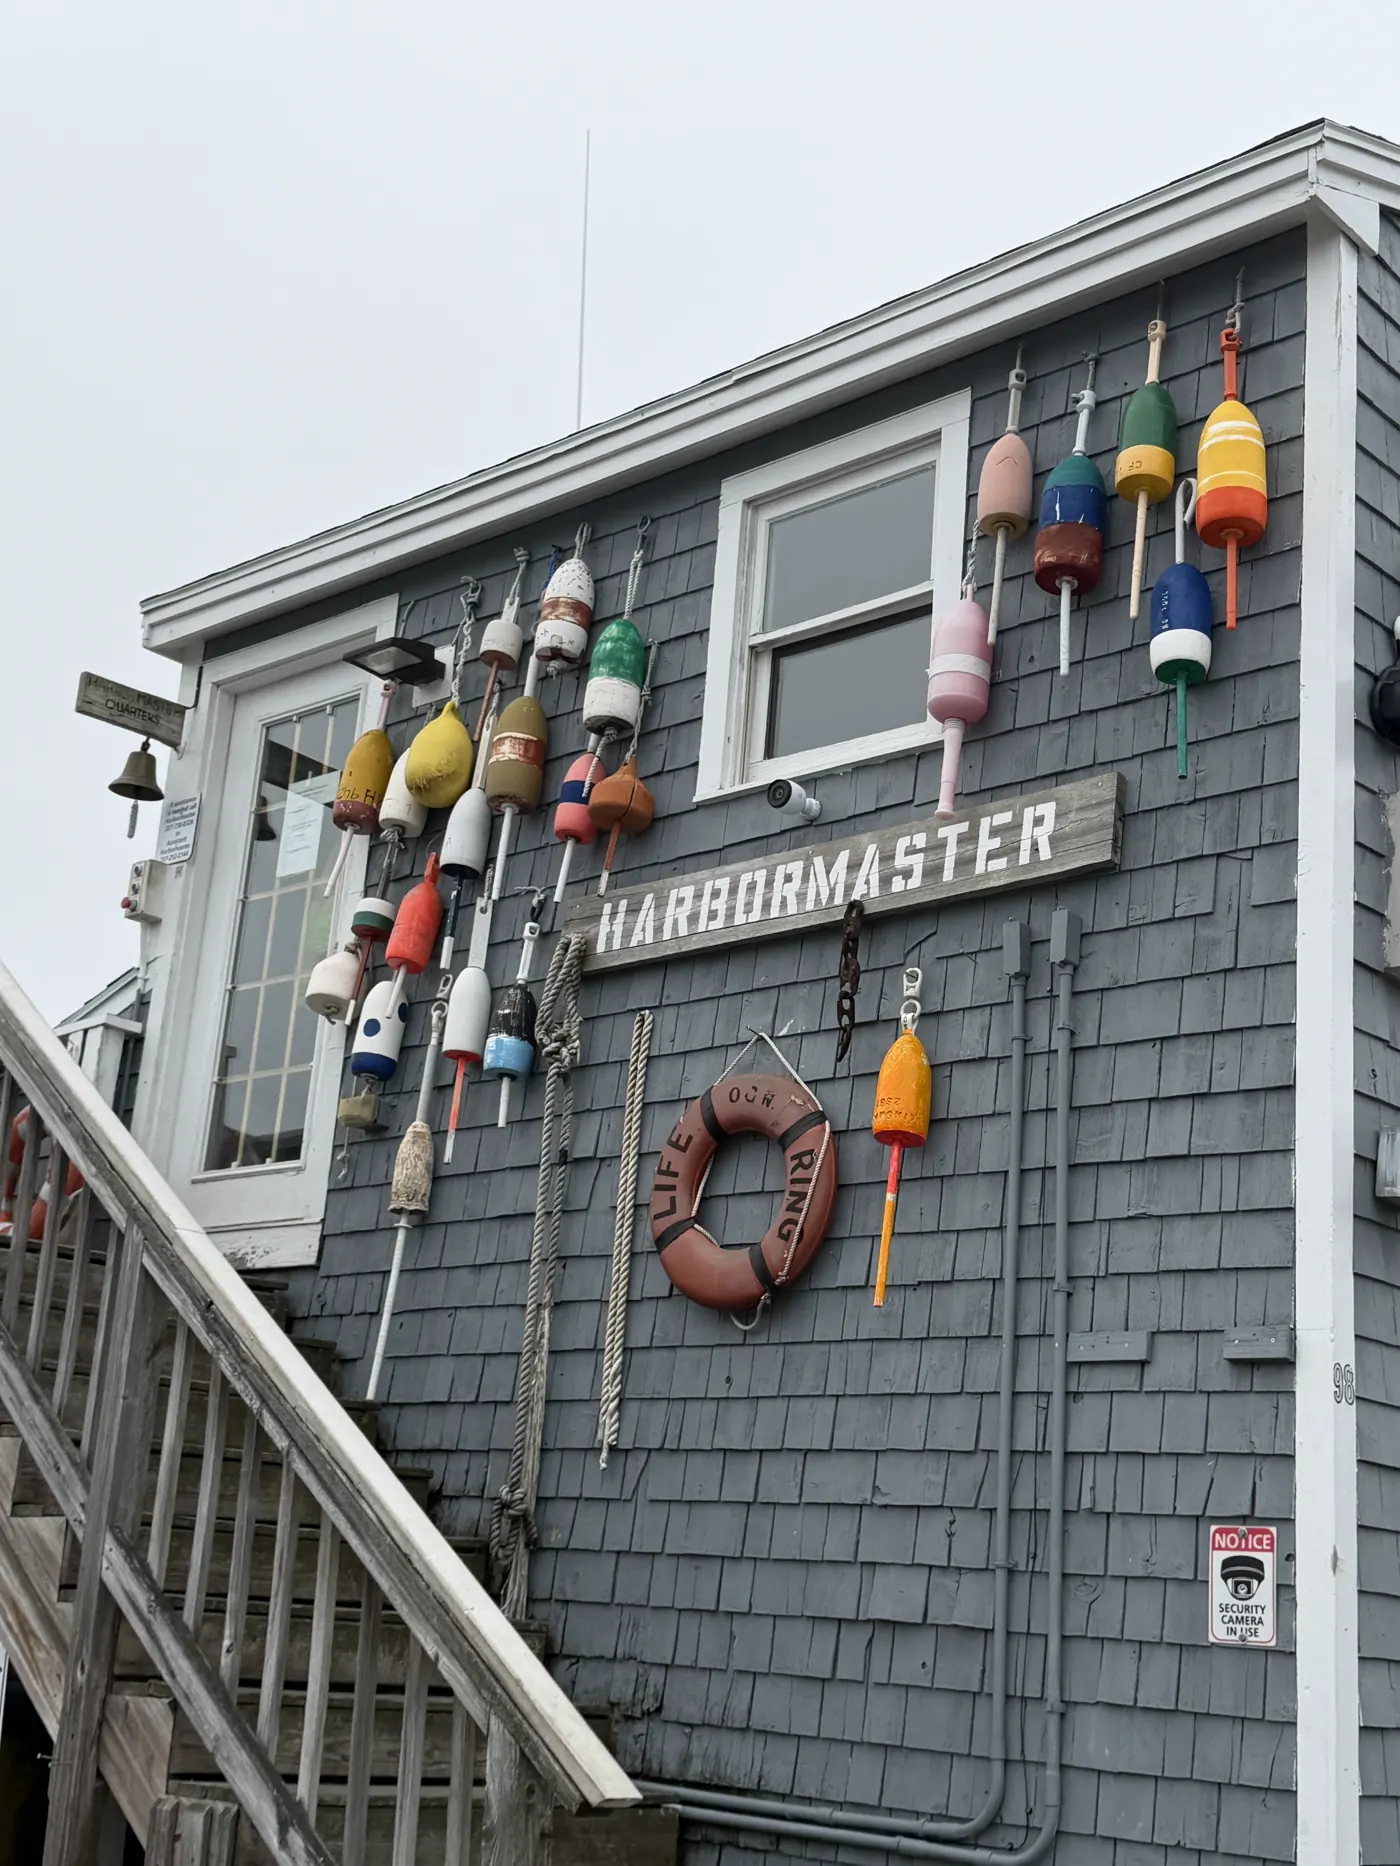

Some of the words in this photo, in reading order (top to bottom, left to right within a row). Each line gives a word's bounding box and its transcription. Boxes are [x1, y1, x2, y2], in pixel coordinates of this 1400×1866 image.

[105, 698, 161, 725] QUARTERS
[596, 800, 1057, 953] HARBORMASTER
[653, 1125, 694, 1221] LIFE
[777, 1148, 818, 1244] RING
[1333, 1362, 1355, 1406] 98
[1214, 1533, 1272, 1550] NOTICE
[1219, 1602, 1267, 1615] SECURITY
[1221, 1614, 1264, 1627] CAMERA
[1226, 1626, 1238, 1637] IN
[1240, 1626, 1260, 1638] USE
